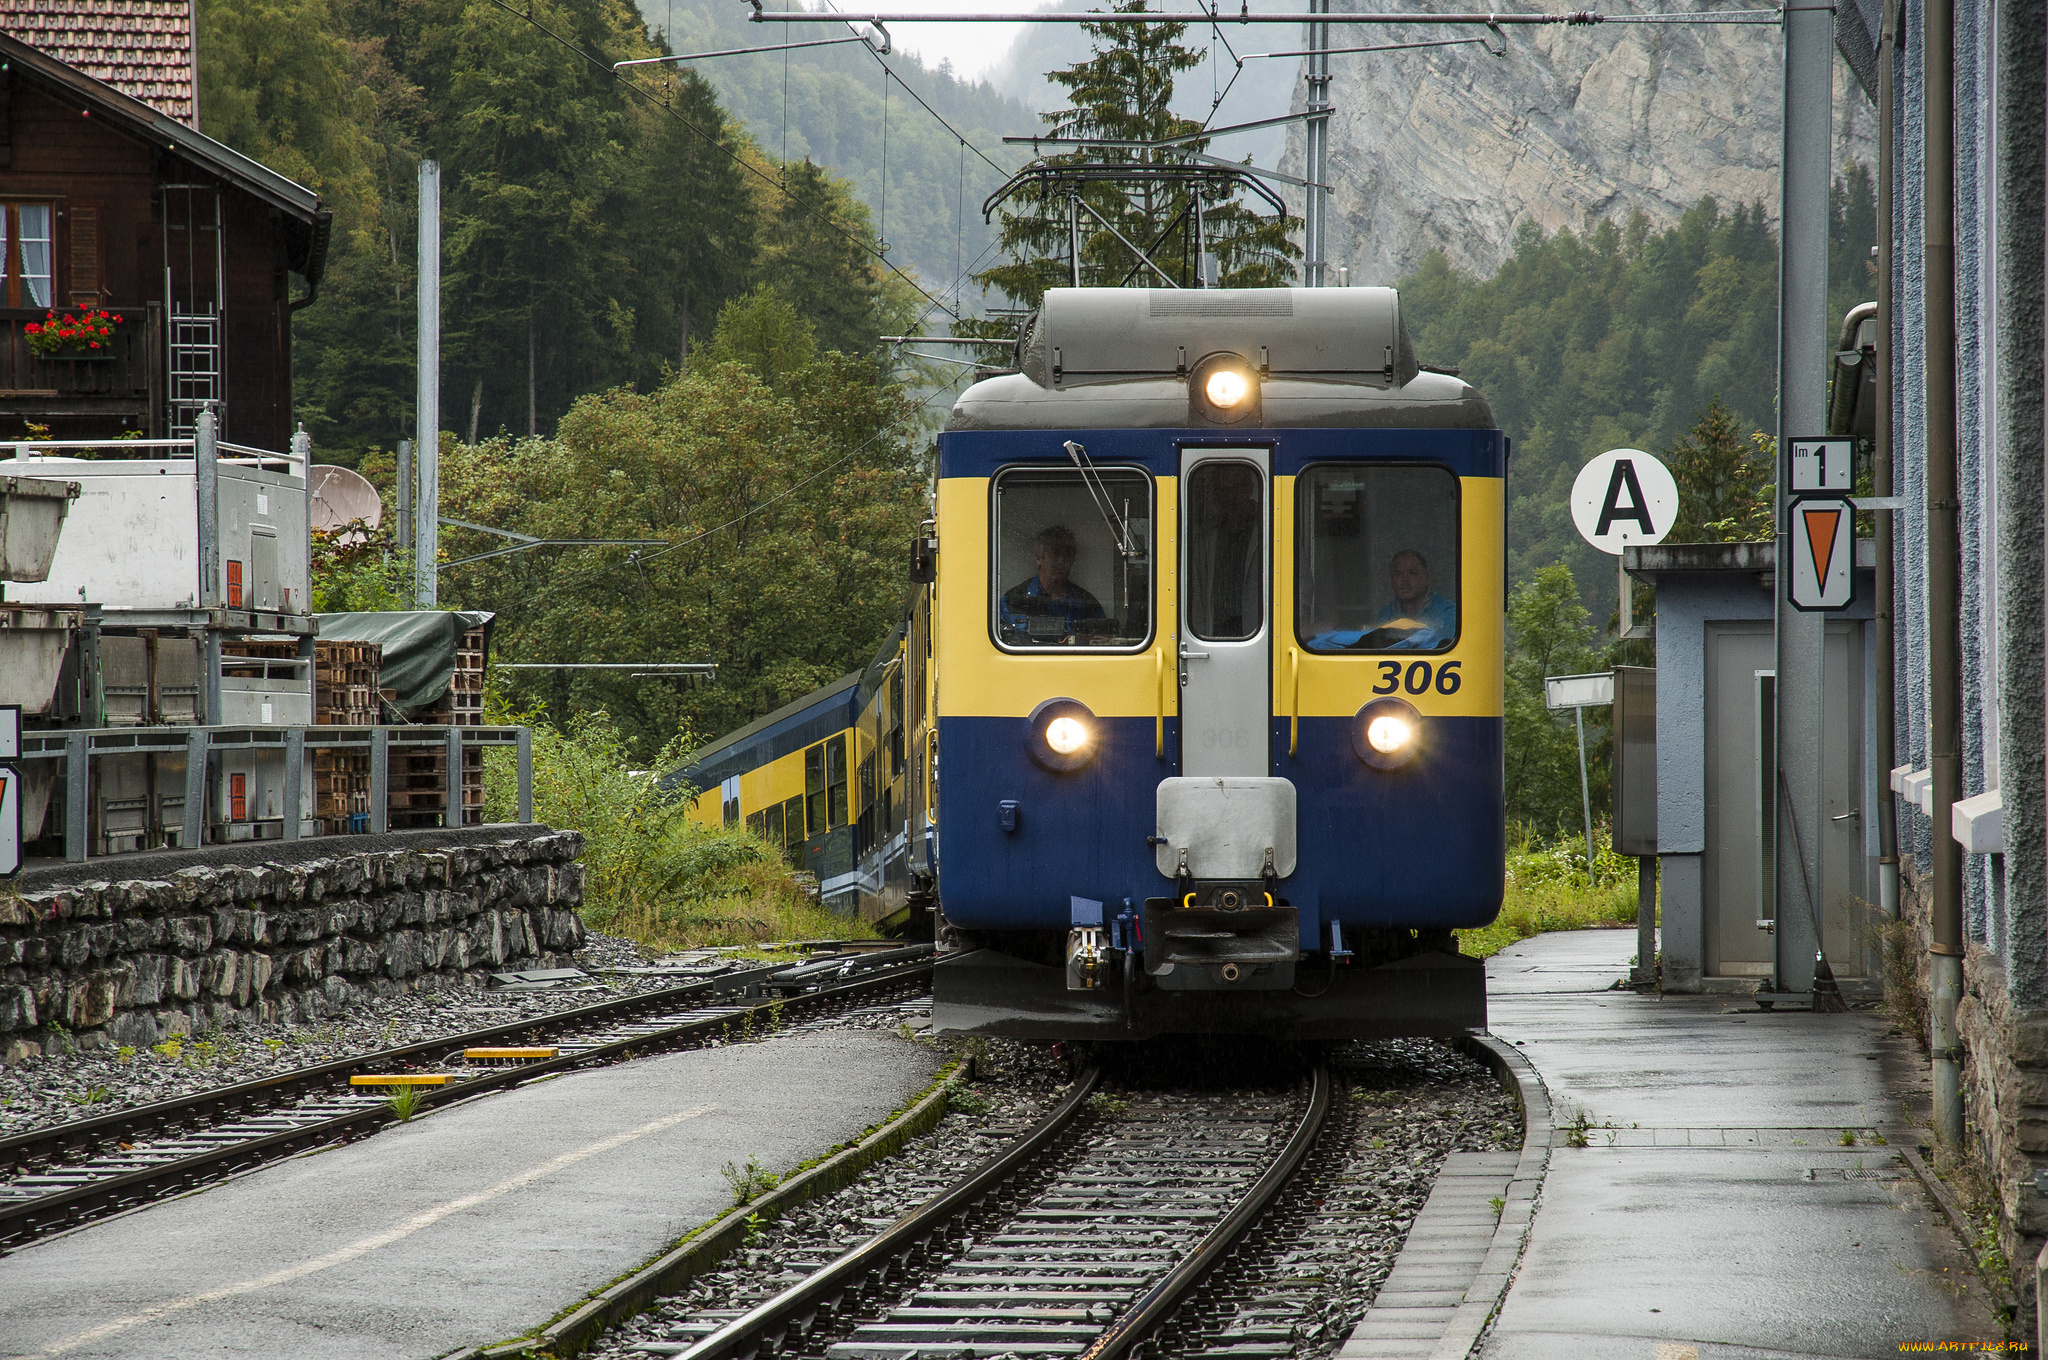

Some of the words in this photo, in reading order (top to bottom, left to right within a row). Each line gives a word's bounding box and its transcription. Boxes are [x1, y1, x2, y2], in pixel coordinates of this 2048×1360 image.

[1813, 445, 1826, 487] 1
[1594, 459, 1656, 536] A
[1372, 660, 1462, 696] 306
[1203, 728, 1250, 749] 306
